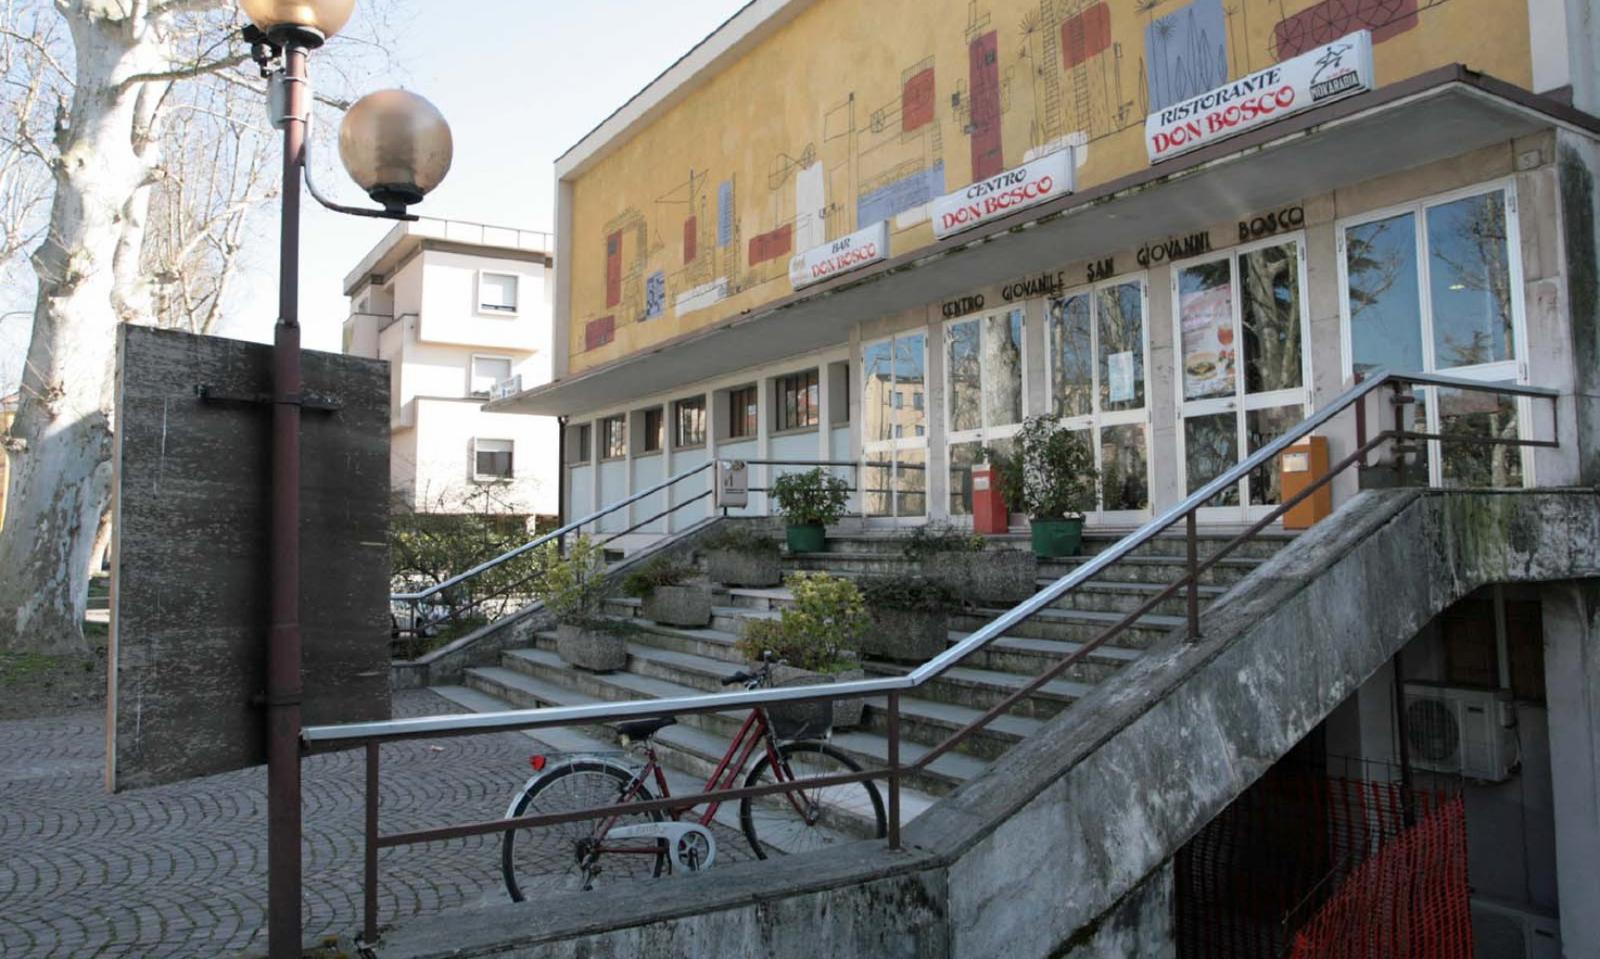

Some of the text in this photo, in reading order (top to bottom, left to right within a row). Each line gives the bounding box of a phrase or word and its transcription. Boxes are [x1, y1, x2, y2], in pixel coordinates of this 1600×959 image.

[1151, 85, 1295, 153] DON BOSCO
[1160, 67, 1281, 127] RISTORANTE
[942, 175, 1053, 230] DON BOSCO
[967, 168, 1027, 199] CENTRO
[811, 242, 876, 277] DON BOSCO
[831, 238, 851, 254] BAR
[942, 206, 1304, 317] CENTRO GIOVANILE SAN GIOVANNI BOSCO
